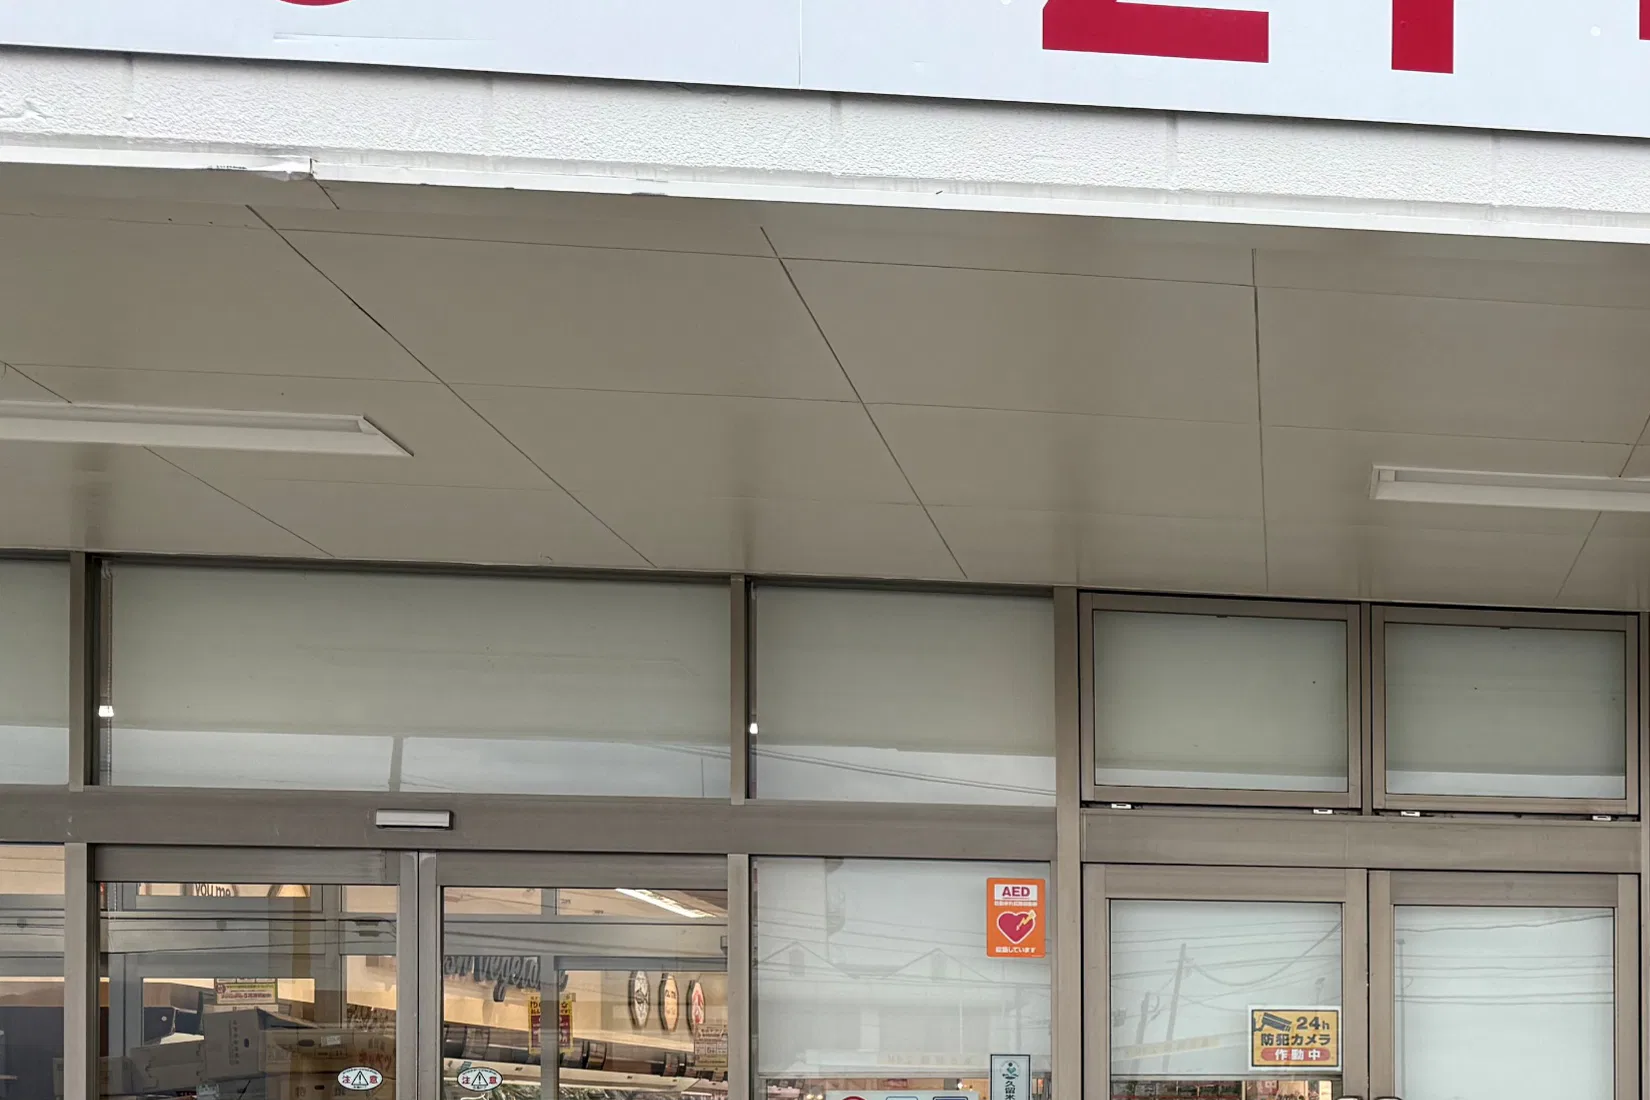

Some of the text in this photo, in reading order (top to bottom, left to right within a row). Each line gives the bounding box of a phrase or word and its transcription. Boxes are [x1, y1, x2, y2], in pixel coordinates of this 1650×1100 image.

[1002, 886, 1031, 897] AED
[1296, 1016, 1330, 1030] 24h
[1261, 1033, 1331, 1046] 防犯カメラ
[1275, 1048, 1320, 1061] 作動中
